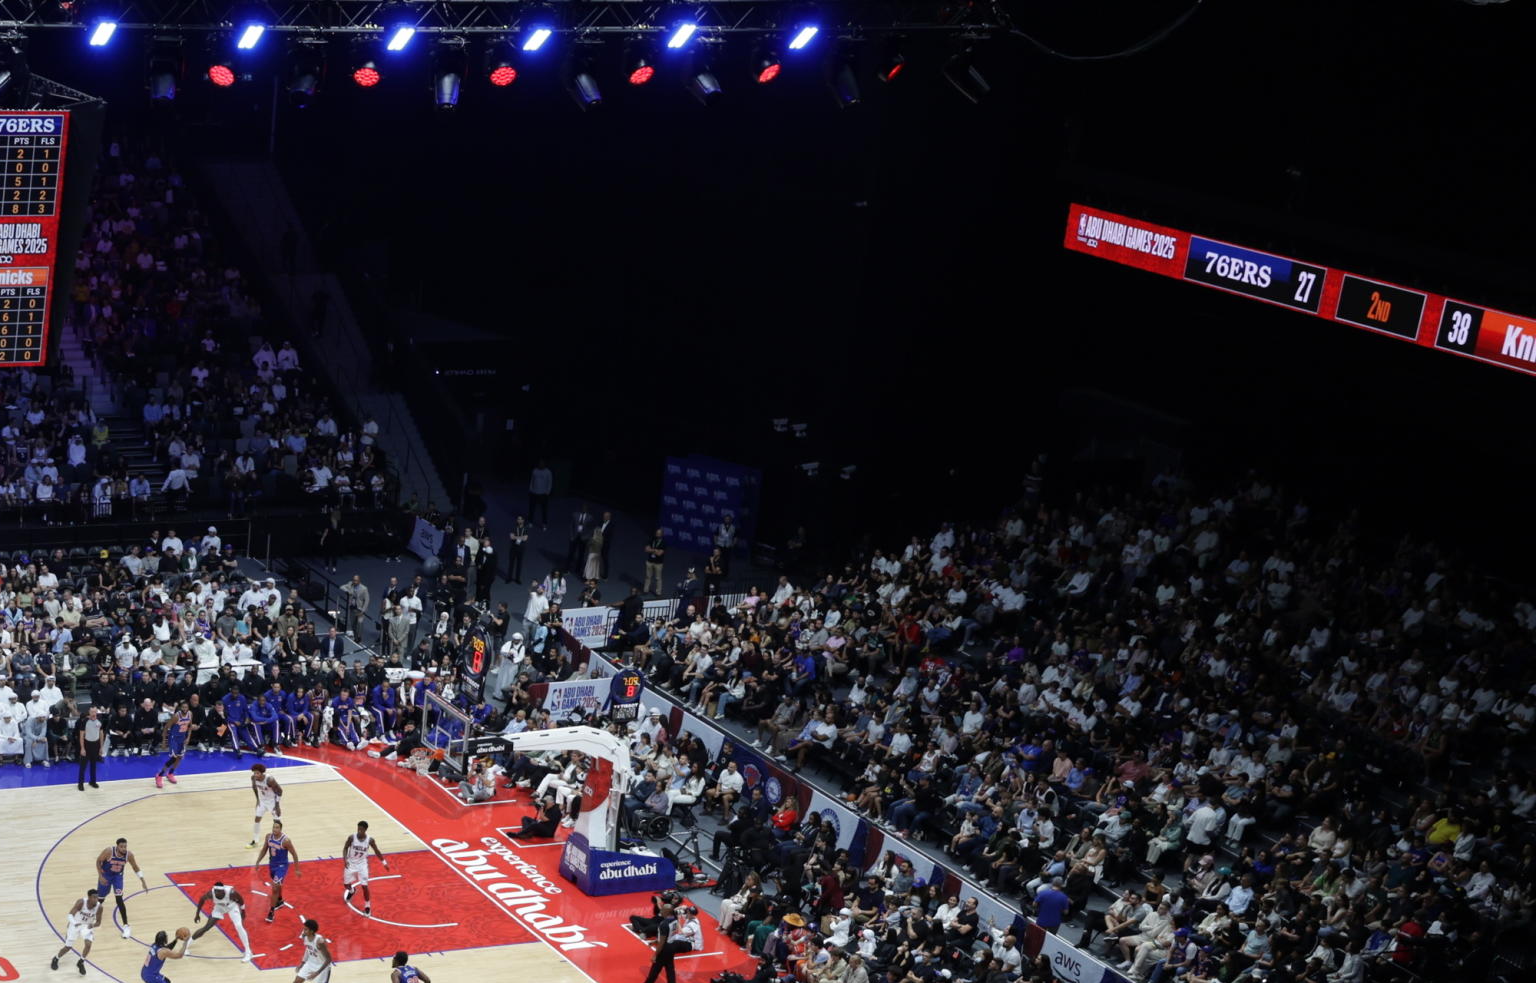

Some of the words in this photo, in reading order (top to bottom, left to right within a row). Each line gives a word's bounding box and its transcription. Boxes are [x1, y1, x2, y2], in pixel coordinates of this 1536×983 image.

[14, 137, 30, 145] PTS
[41, 137, 55, 145] FLS
[17, 149, 24, 159] 2
[44, 149, 49, 159] 1
[16, 163, 23, 173] 0
[42, 163, 49, 173] 0
[15, 177, 22, 187] 5
[41, 177, 47, 187] 1
[13, 191, 20, 201] 2
[39, 191, 46, 201] 2
[12, 204, 19, 214] 8
[38, 204, 45, 214] 3
[15, 223, 41, 238] DHABI
[1085, 216, 1102, 239] ABU
[1101, 219, 1126, 247] DHABI
[1126, 226, 1154, 254] GAMES
[1152, 233, 1177, 260] 2025
[25, 238, 48, 253] 2025
[1205, 251, 1272, 288] 76ERS
[1294, 271, 1316, 303] 27
[0, 288, 16, 296] PTS
[4, 299, 10, 309] 2
[29, 299, 36, 308] 0
[1367, 291, 1392, 323] 2ND
[3, 313, 9, 322] 6
[29, 312, 34, 321] 1
[1, 326, 8, 335] 6
[27, 325, 32, 334] 1
[1447, 310, 1472, 346] 38
[0, 339, 7, 348] 0
[25, 338, 32, 347] 0
[0, 352, 5, 361] 2
[24, 351, 31, 360] 0
[626, 685, 635, 697] 8
[480, 836, 563, 894] experience
[600, 860, 631, 868] experience
[599, 868, 623, 880] abu
[624, 862, 657, 878] dhabi
[431, 838, 508, 881] abu
[487, 882, 609, 951] dhabi
[1054, 951, 1081, 977] aws
